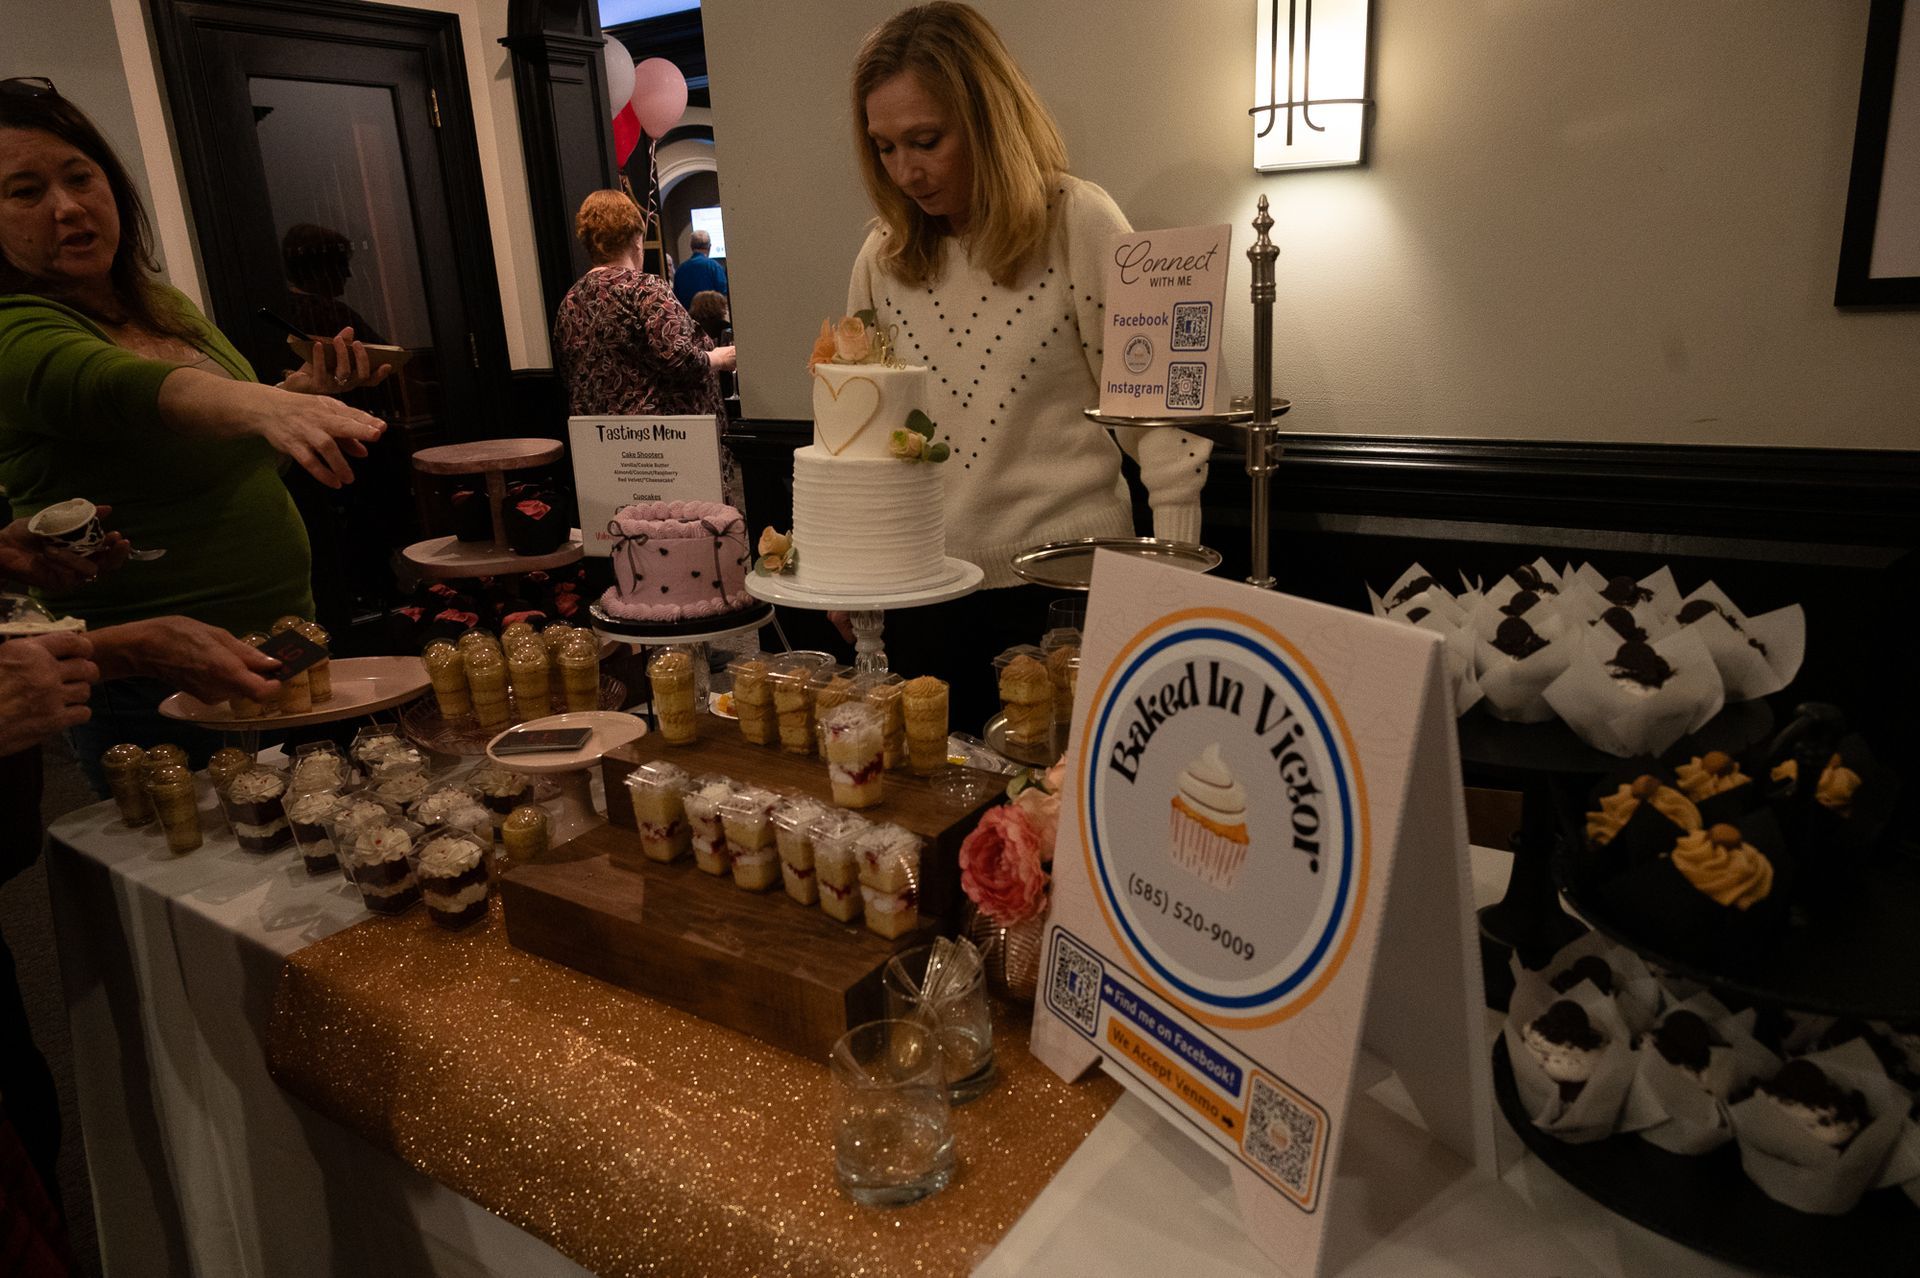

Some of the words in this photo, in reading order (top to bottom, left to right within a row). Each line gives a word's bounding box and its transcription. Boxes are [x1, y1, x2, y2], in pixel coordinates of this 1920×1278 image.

[1115, 240, 1218, 284] Connect
[1150, 276, 1174, 287] WITH
[1177, 276, 1192, 286] ME
[1113, 312, 1169, 326] Facebook
[1107, 381, 1164, 397] Instagram
[595, 425, 650, 442] Tastings
[653, 424, 686, 441] Menu
[621, 451, 636, 459] Cake
[637, 451, 664, 459] Shooters
[633, 493, 662, 501] Cupcakes
[1109, 661, 1200, 784] Baked
[1207, 661, 1246, 716] In
[1254, 683, 1323, 875] Victor
[1128, 872, 1169, 915] (585)
[1173, 906, 1255, 961] 520-9009
[1114, 989, 1137, 1016] Find
[1138, 1011, 1156, 1029] me
[1157, 1023, 1173, 1043] on
[1174, 1032, 1236, 1087] Facebook!
[1111, 1026, 1129, 1049] We
[1131, 1039, 1174, 1084] Accept
[1175, 1072, 1219, 1117] Venmo
